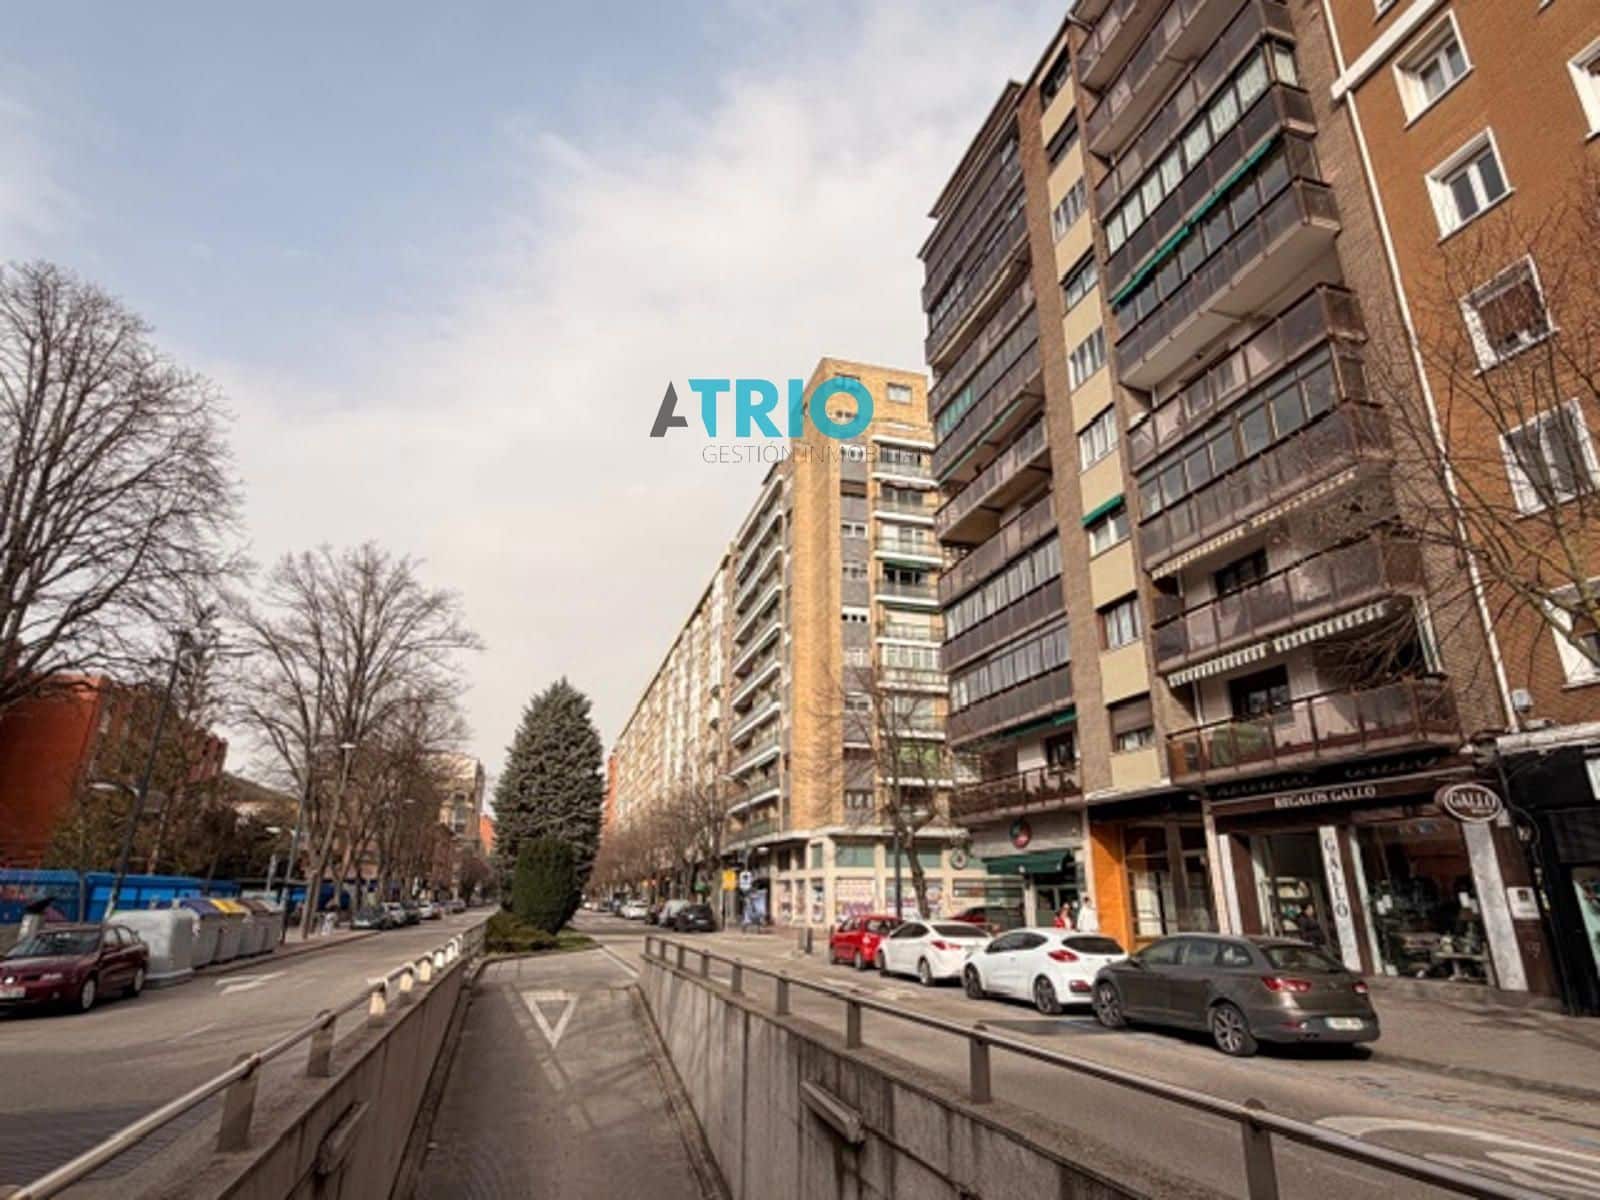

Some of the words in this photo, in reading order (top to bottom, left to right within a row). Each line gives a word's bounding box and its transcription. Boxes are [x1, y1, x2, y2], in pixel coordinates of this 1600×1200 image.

[1331, 785, 1377, 802] GALLO
[1448, 790, 1497, 809] GALLO
[1323, 838, 1349, 919] GALLO
